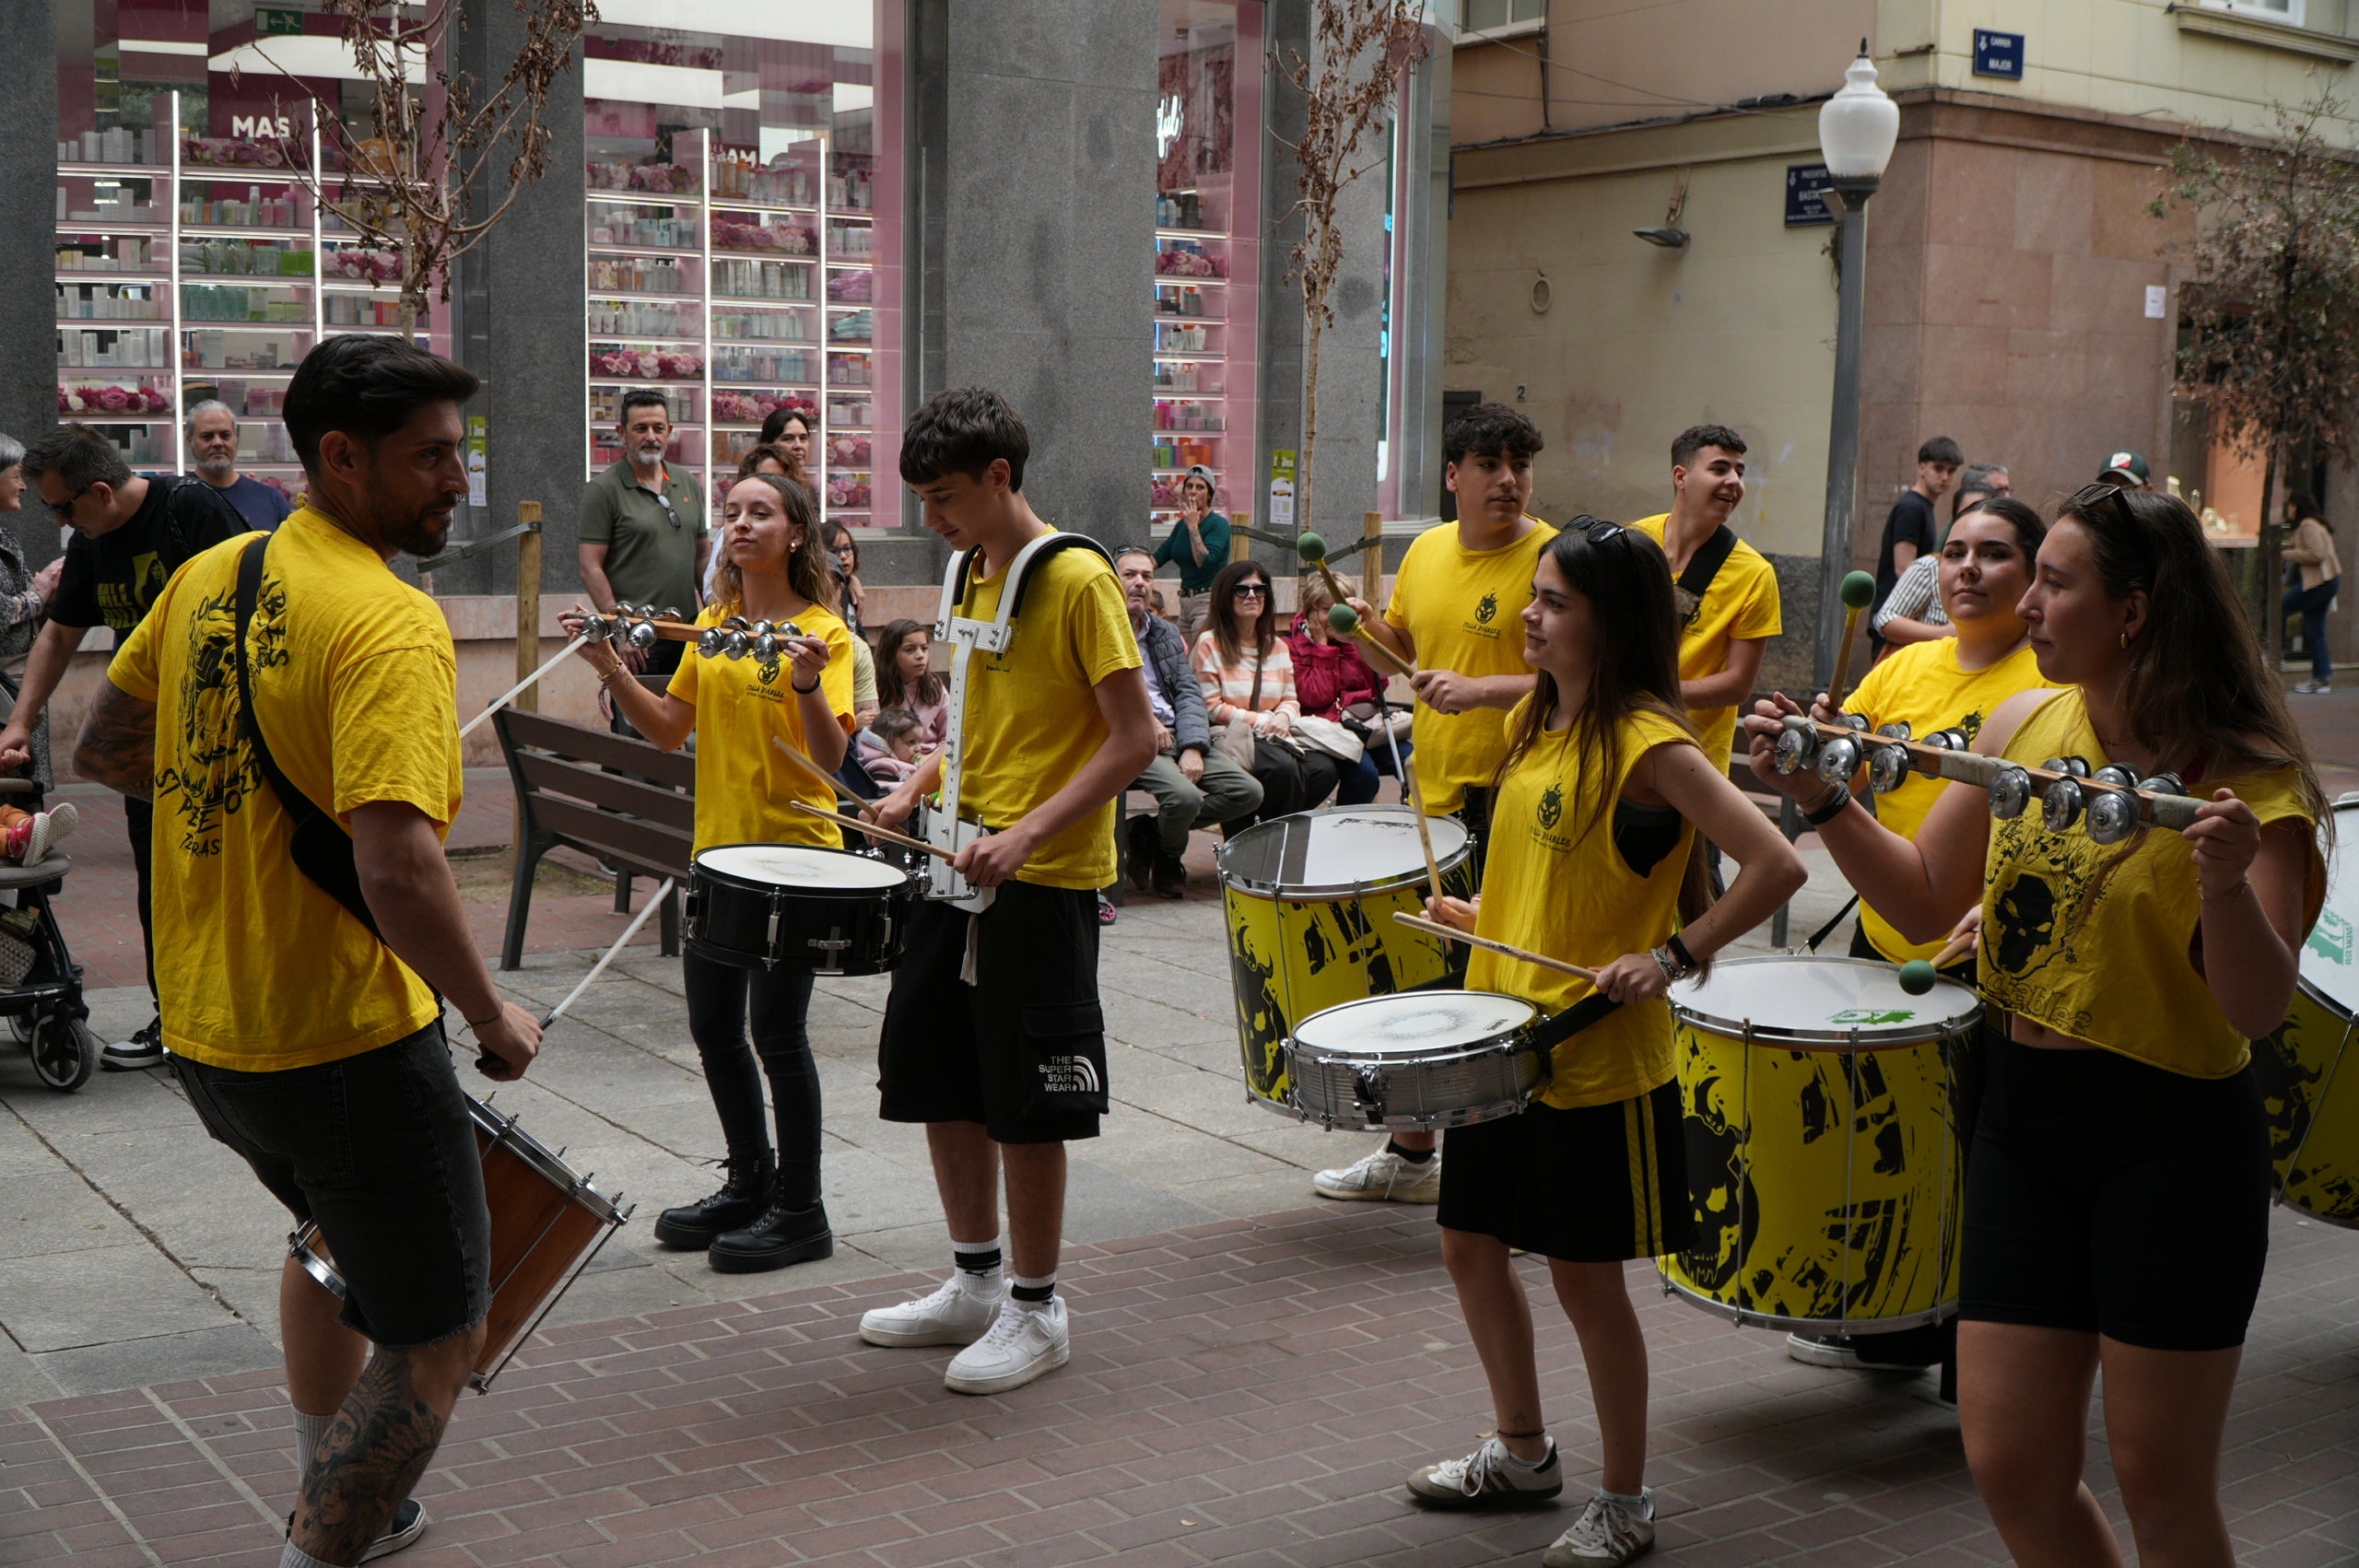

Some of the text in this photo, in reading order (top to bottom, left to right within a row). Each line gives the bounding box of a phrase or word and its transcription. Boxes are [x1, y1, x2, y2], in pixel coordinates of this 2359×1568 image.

[1989, 57, 2013, 71] MAJOR
[232, 115, 290, 138] MAS
[1517, 385, 1526, 400] 2
[1050, 1056, 1073, 1065] THE
[1038, 1064, 1072, 1074] SUPER
[1047, 1074, 1072, 1082] STAR
[1044, 1082, 1072, 1092] WEAR
